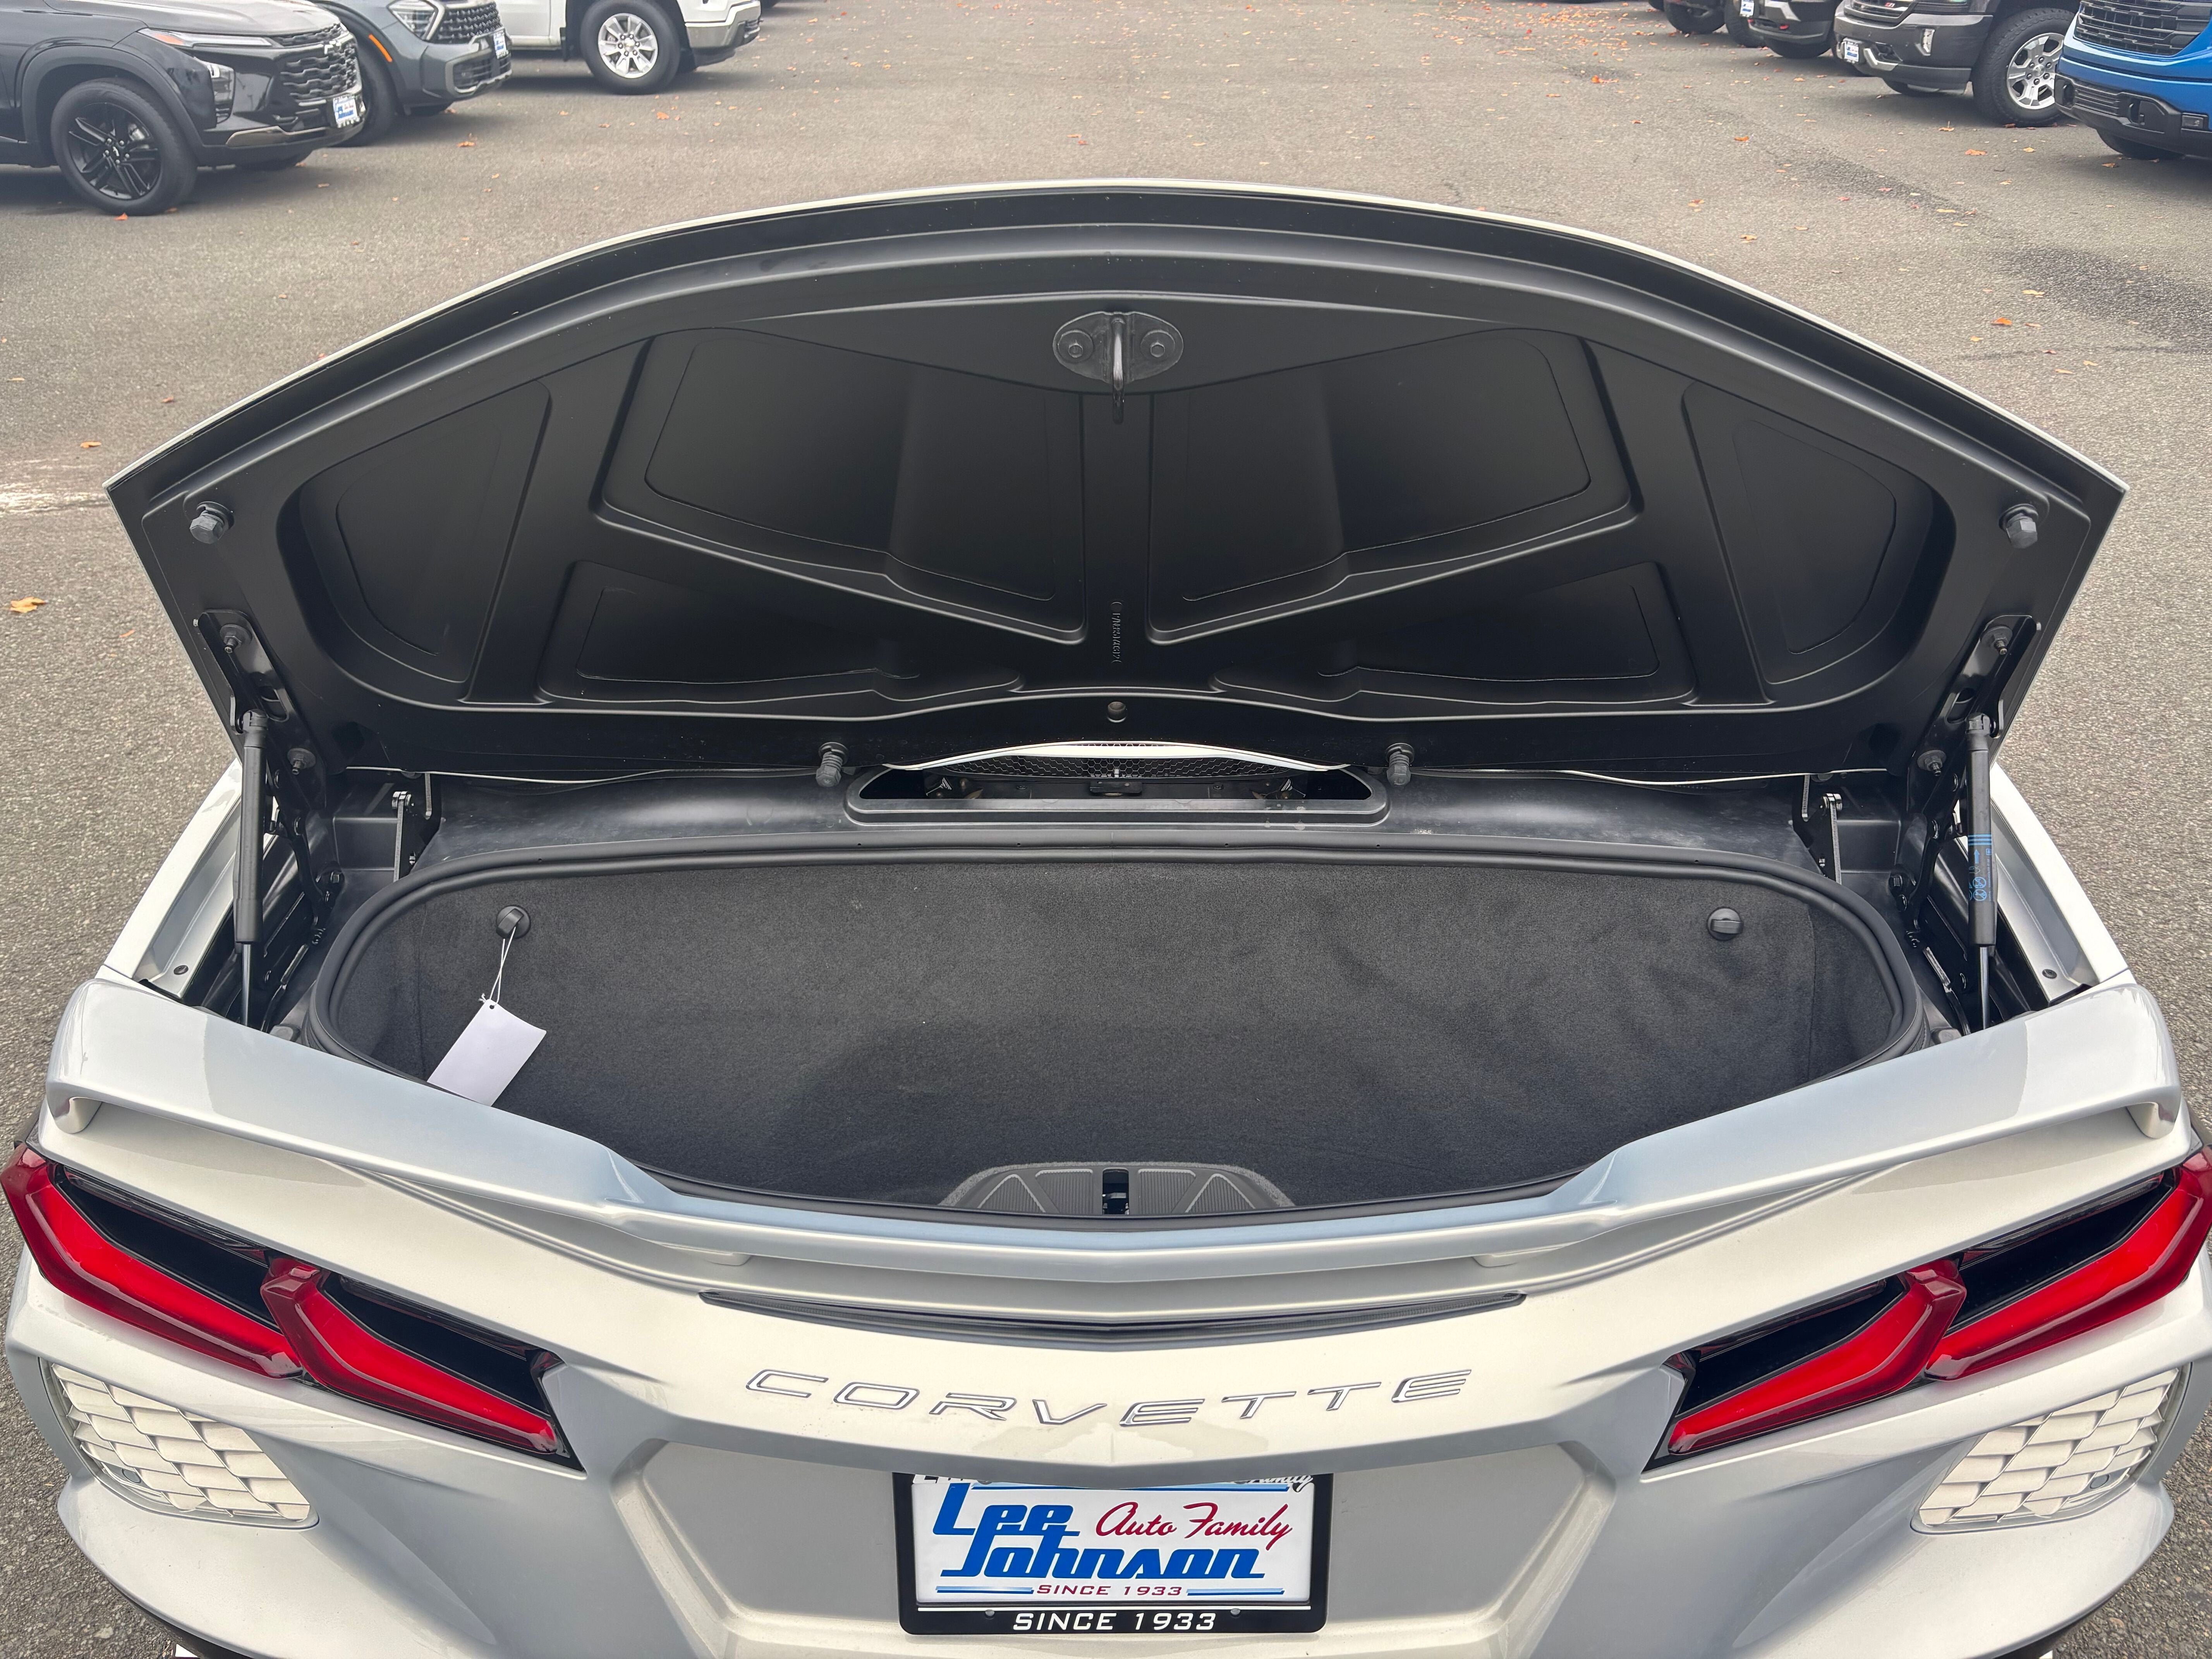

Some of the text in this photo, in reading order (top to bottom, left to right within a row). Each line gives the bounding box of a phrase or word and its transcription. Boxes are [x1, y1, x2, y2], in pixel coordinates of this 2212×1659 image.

[745, 1368, 1472, 1428] CORVETTE
[933, 1482, 1080, 1536] Lee
[1095, 1501, 1293, 1551] Auto Family
[940, 1535, 1266, 1579] Johnson
[1036, 1585, 1182, 1596] SINCE 1933
[1013, 1612, 1216, 1631] SINCE 1933
